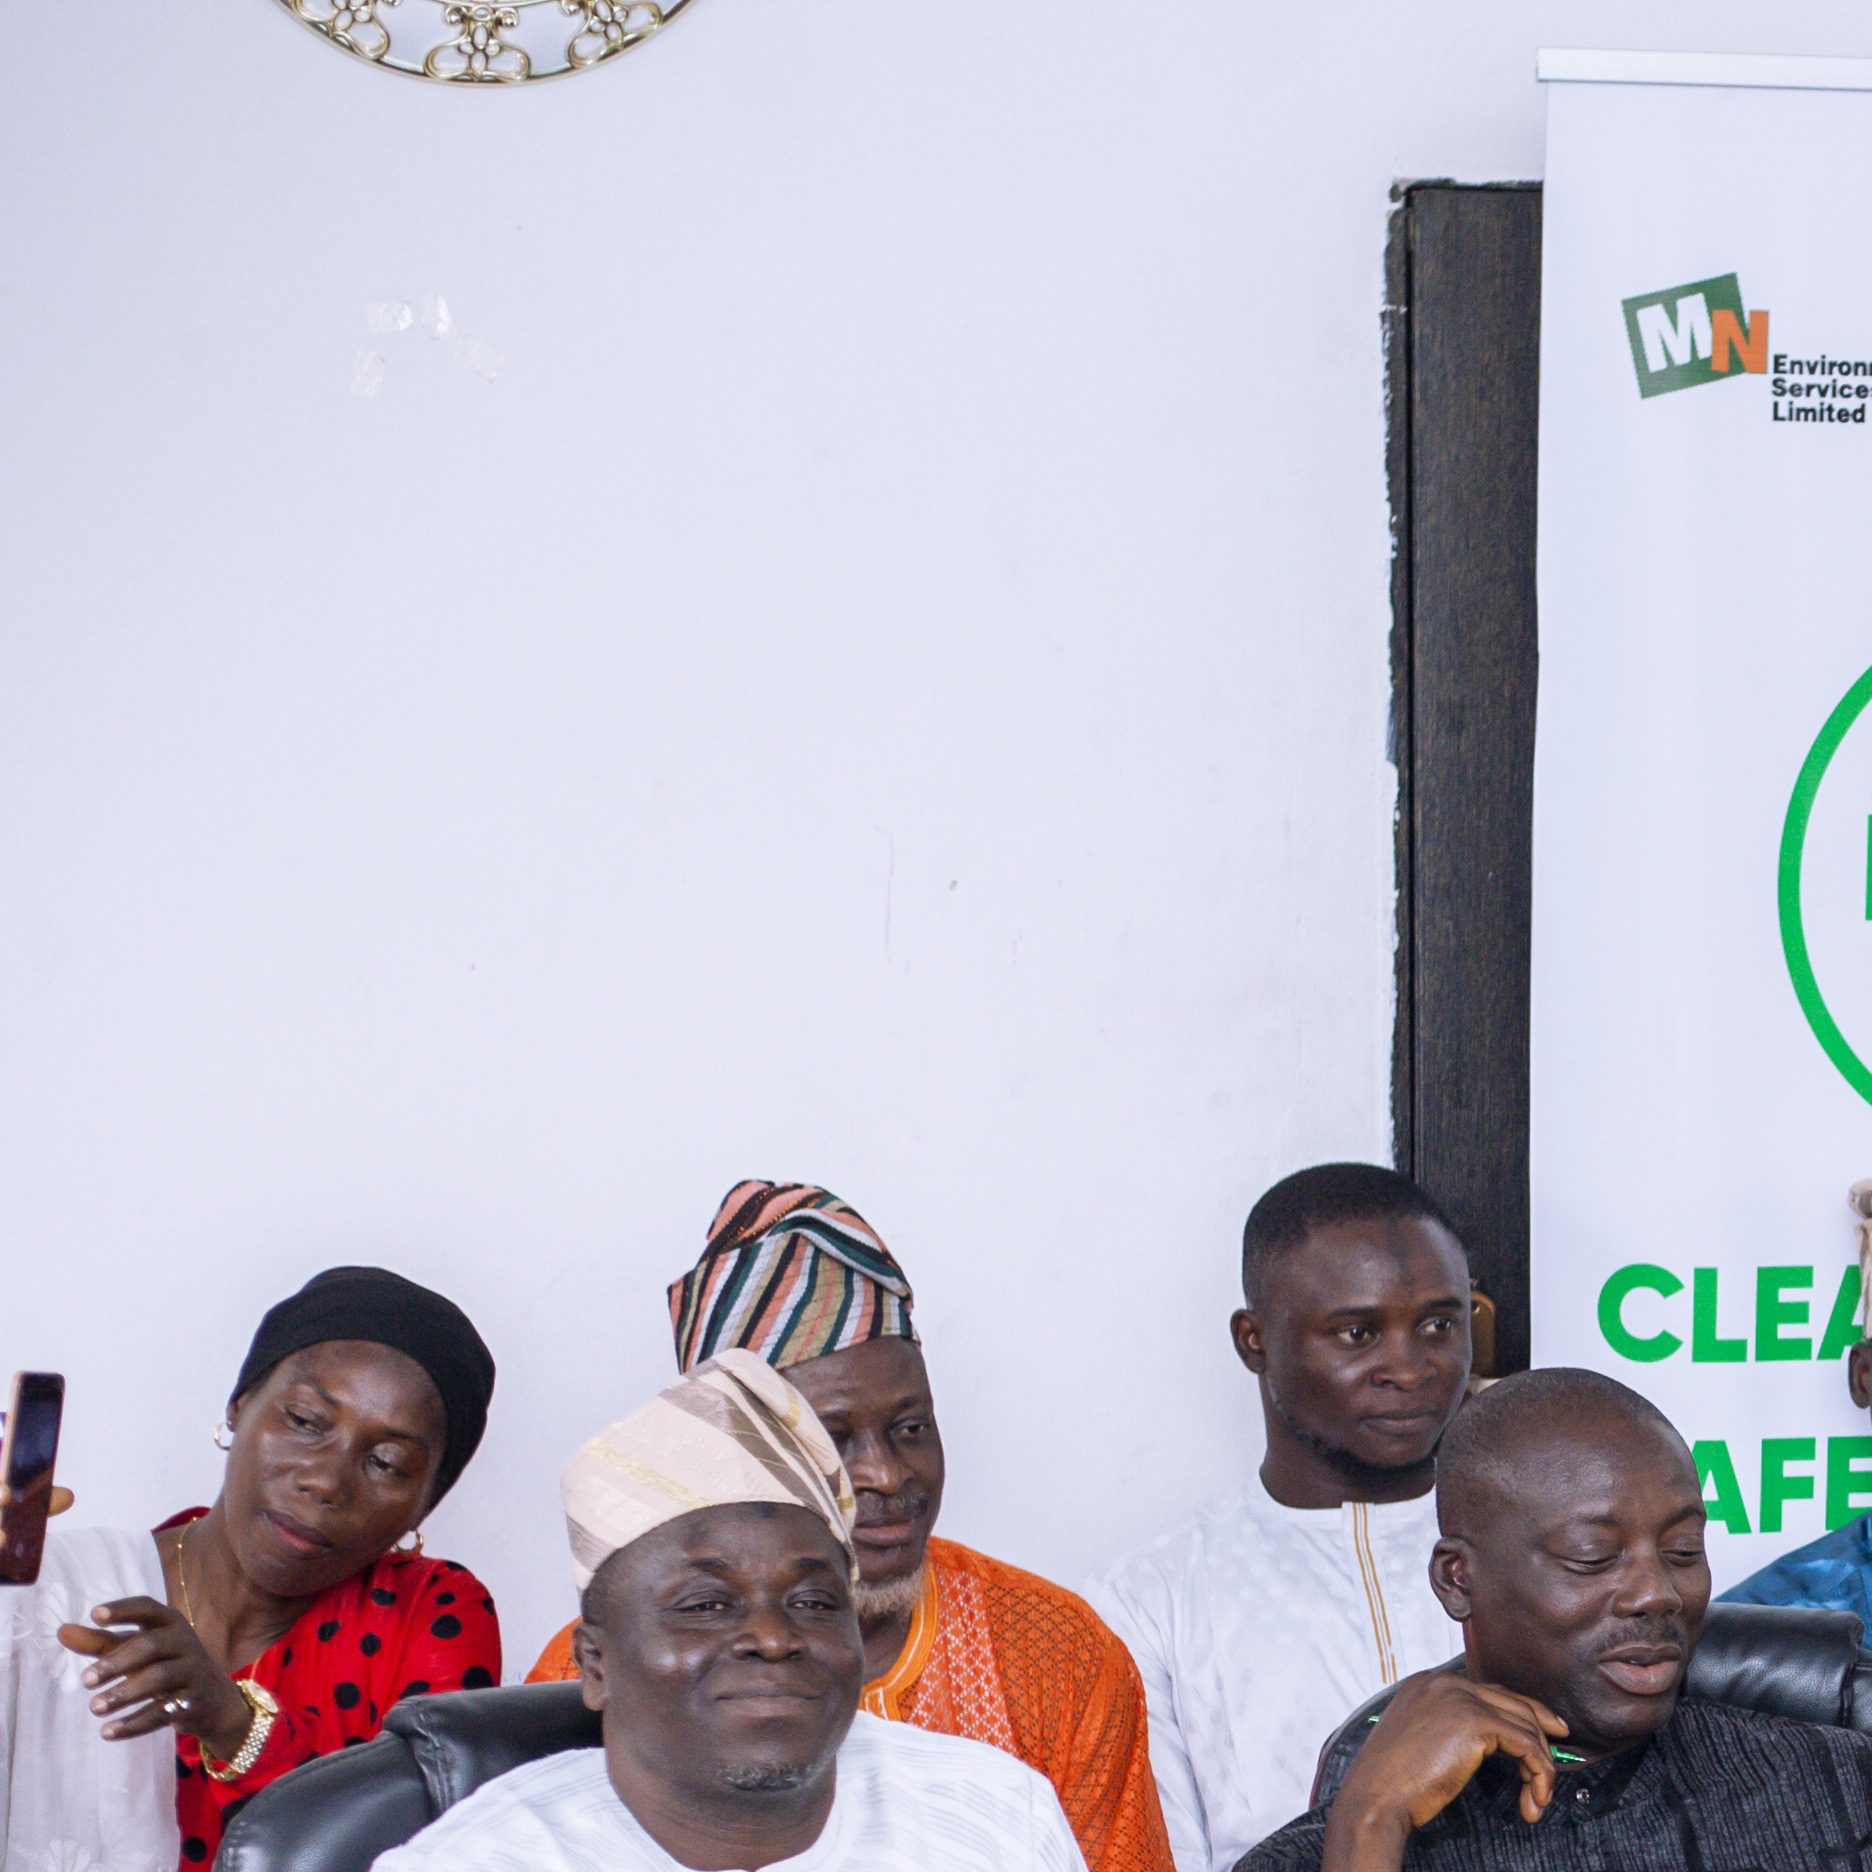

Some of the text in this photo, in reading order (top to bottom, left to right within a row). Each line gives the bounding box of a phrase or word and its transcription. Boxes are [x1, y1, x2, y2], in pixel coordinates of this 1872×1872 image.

[1636, 292, 1769, 374] MN
[1773, 402, 1866, 423] Limited
[1597, 1263, 1866, 1363] CLEA
